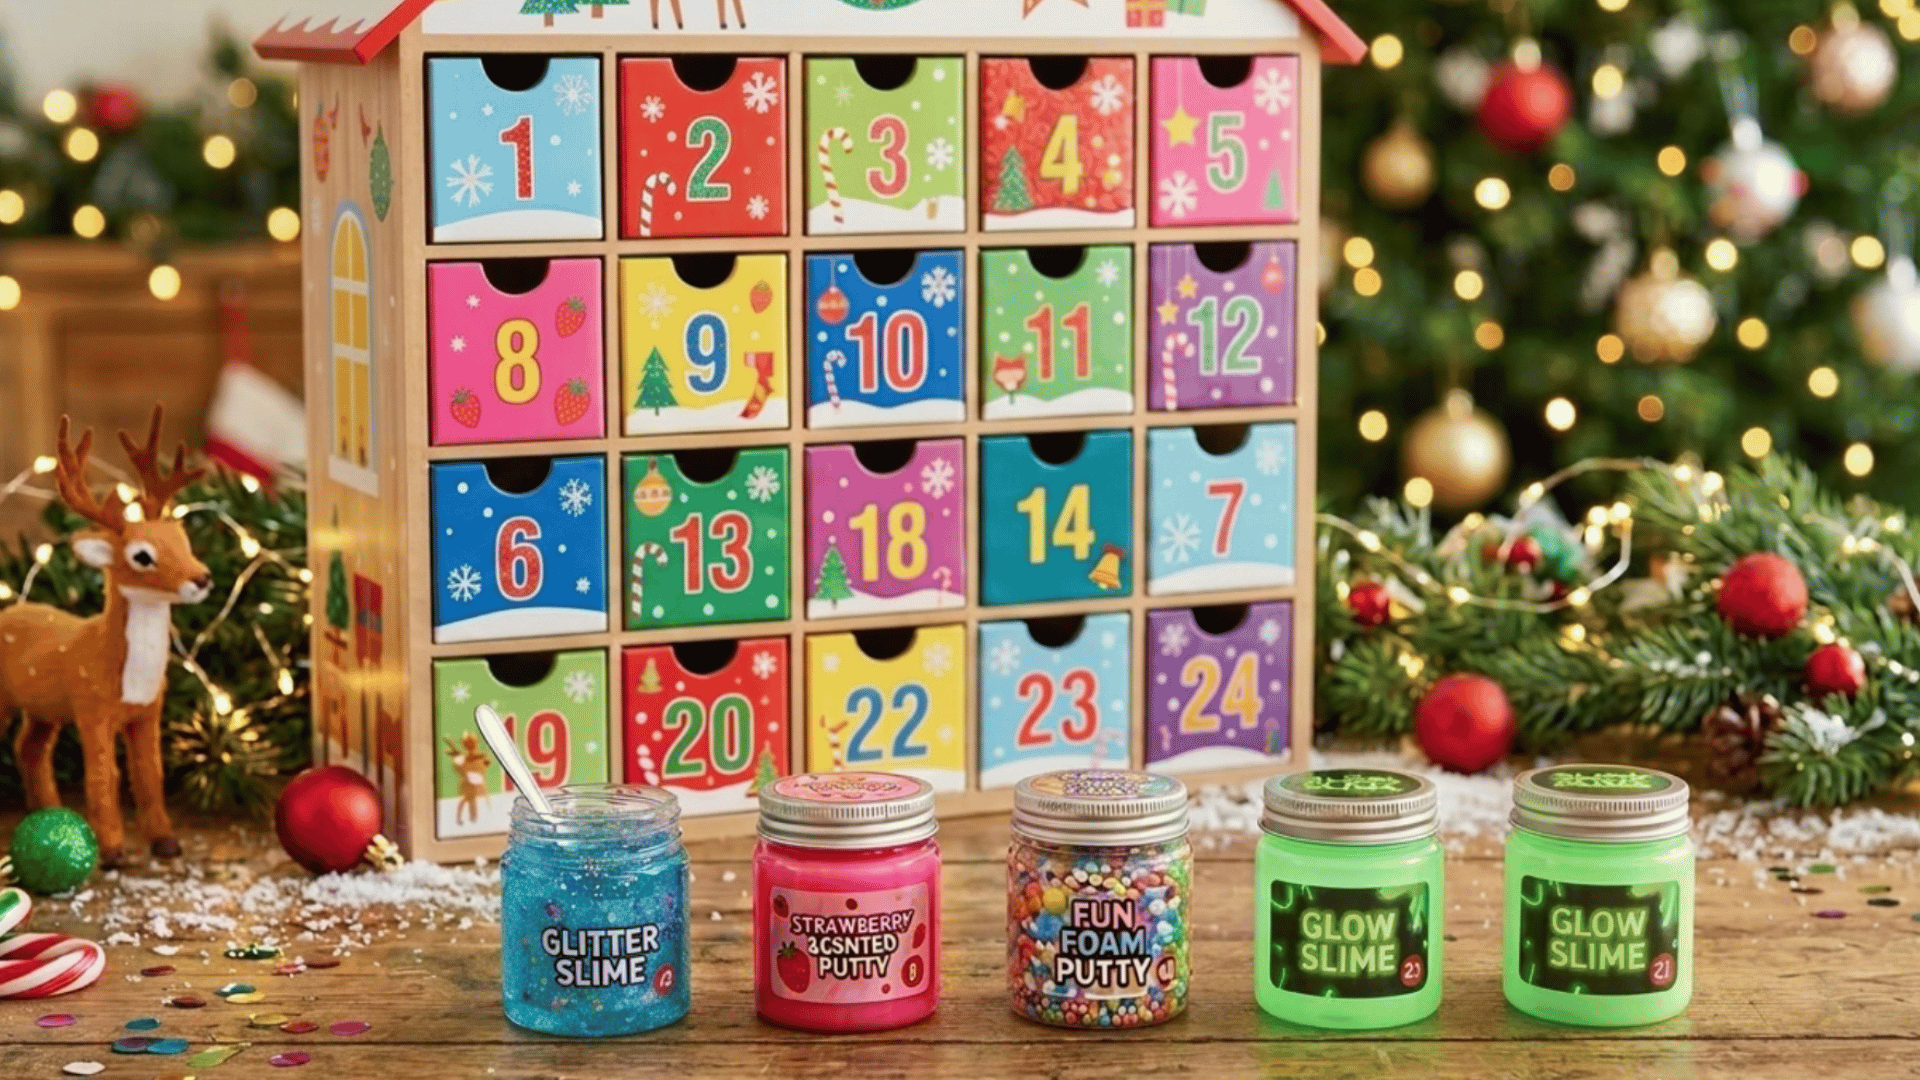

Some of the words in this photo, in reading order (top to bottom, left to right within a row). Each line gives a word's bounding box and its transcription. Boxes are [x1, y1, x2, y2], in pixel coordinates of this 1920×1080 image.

[498, 115, 534, 200] 1
[685, 116, 731, 202] 2
[867, 113, 911, 199] 3
[1039, 113, 1083, 197] 4
[1206, 111, 1247, 193] 5
[494, 317, 542, 405] 8
[683, 309, 729, 395] 9
[845, 308, 928, 394] 10
[1025, 302, 1091, 382] 11
[1187, 295, 1263, 376] 12
[495, 515, 544, 601] 6
[670, 509, 754, 595] 13
[849, 501, 928, 581] 18
[1016, 483, 1095, 564] 14
[1206, 478, 1247, 558] 7
[845, 682, 930, 763] 22
[1015, 668, 1099, 748] 23
[1179, 651, 1263, 734] 24
[661, 692, 755, 780] 20
[541, 924, 660, 957] GLITTER
[791, 909, 915, 934] STRAWBERRY
[1061, 928, 1147, 956] FOAM
[1073, 900, 1134, 929] FUN
[1301, 911, 1396, 941] GLOW
[1551, 907, 1647, 938] GLOW
[554, 956, 646, 987] SLIME
[1055, 956, 1152, 986] PUTTY
[1300, 943, 1396, 973] SLIME
[1550, 940, 1646, 970] SLIME
[1653, 959, 1670, 980] 21
